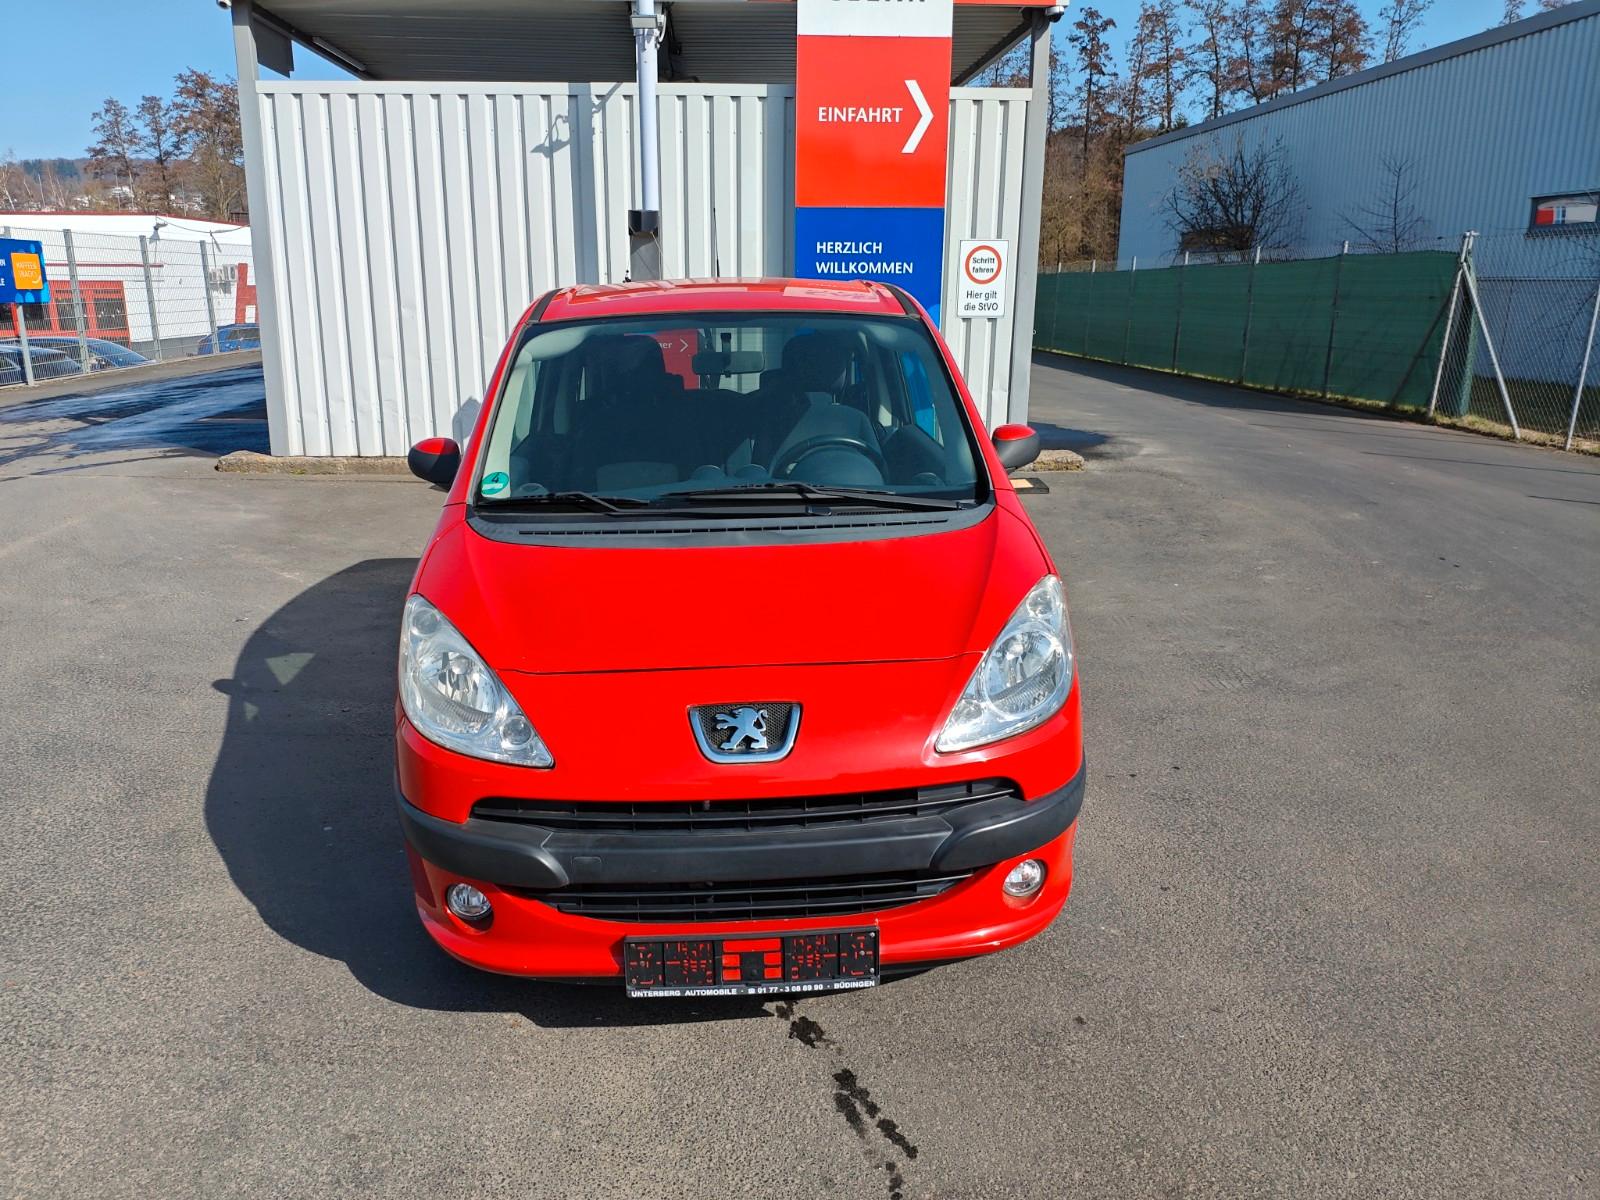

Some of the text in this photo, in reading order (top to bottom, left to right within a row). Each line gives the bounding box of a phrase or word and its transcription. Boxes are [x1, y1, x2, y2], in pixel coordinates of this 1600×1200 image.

[818, 106, 903, 123] EINFAHRT
[816, 241, 883, 254] HERZLICH
[816, 261, 913, 274] WILLKOMMEN
[972, 266, 994, 274] fahren
[966, 290, 997, 301] Hier gilt
[964, 302, 998, 311] die StVO
[491, 472, 500, 483] 4
[631, 990, 681, 998] UNTERBERG
[684, 988, 737, 997] AUTOMOBILE
[757, 986, 767, 994] 01
[768, 985, 779, 993] 77
[833, 980, 875, 989] BÜDINGEN
